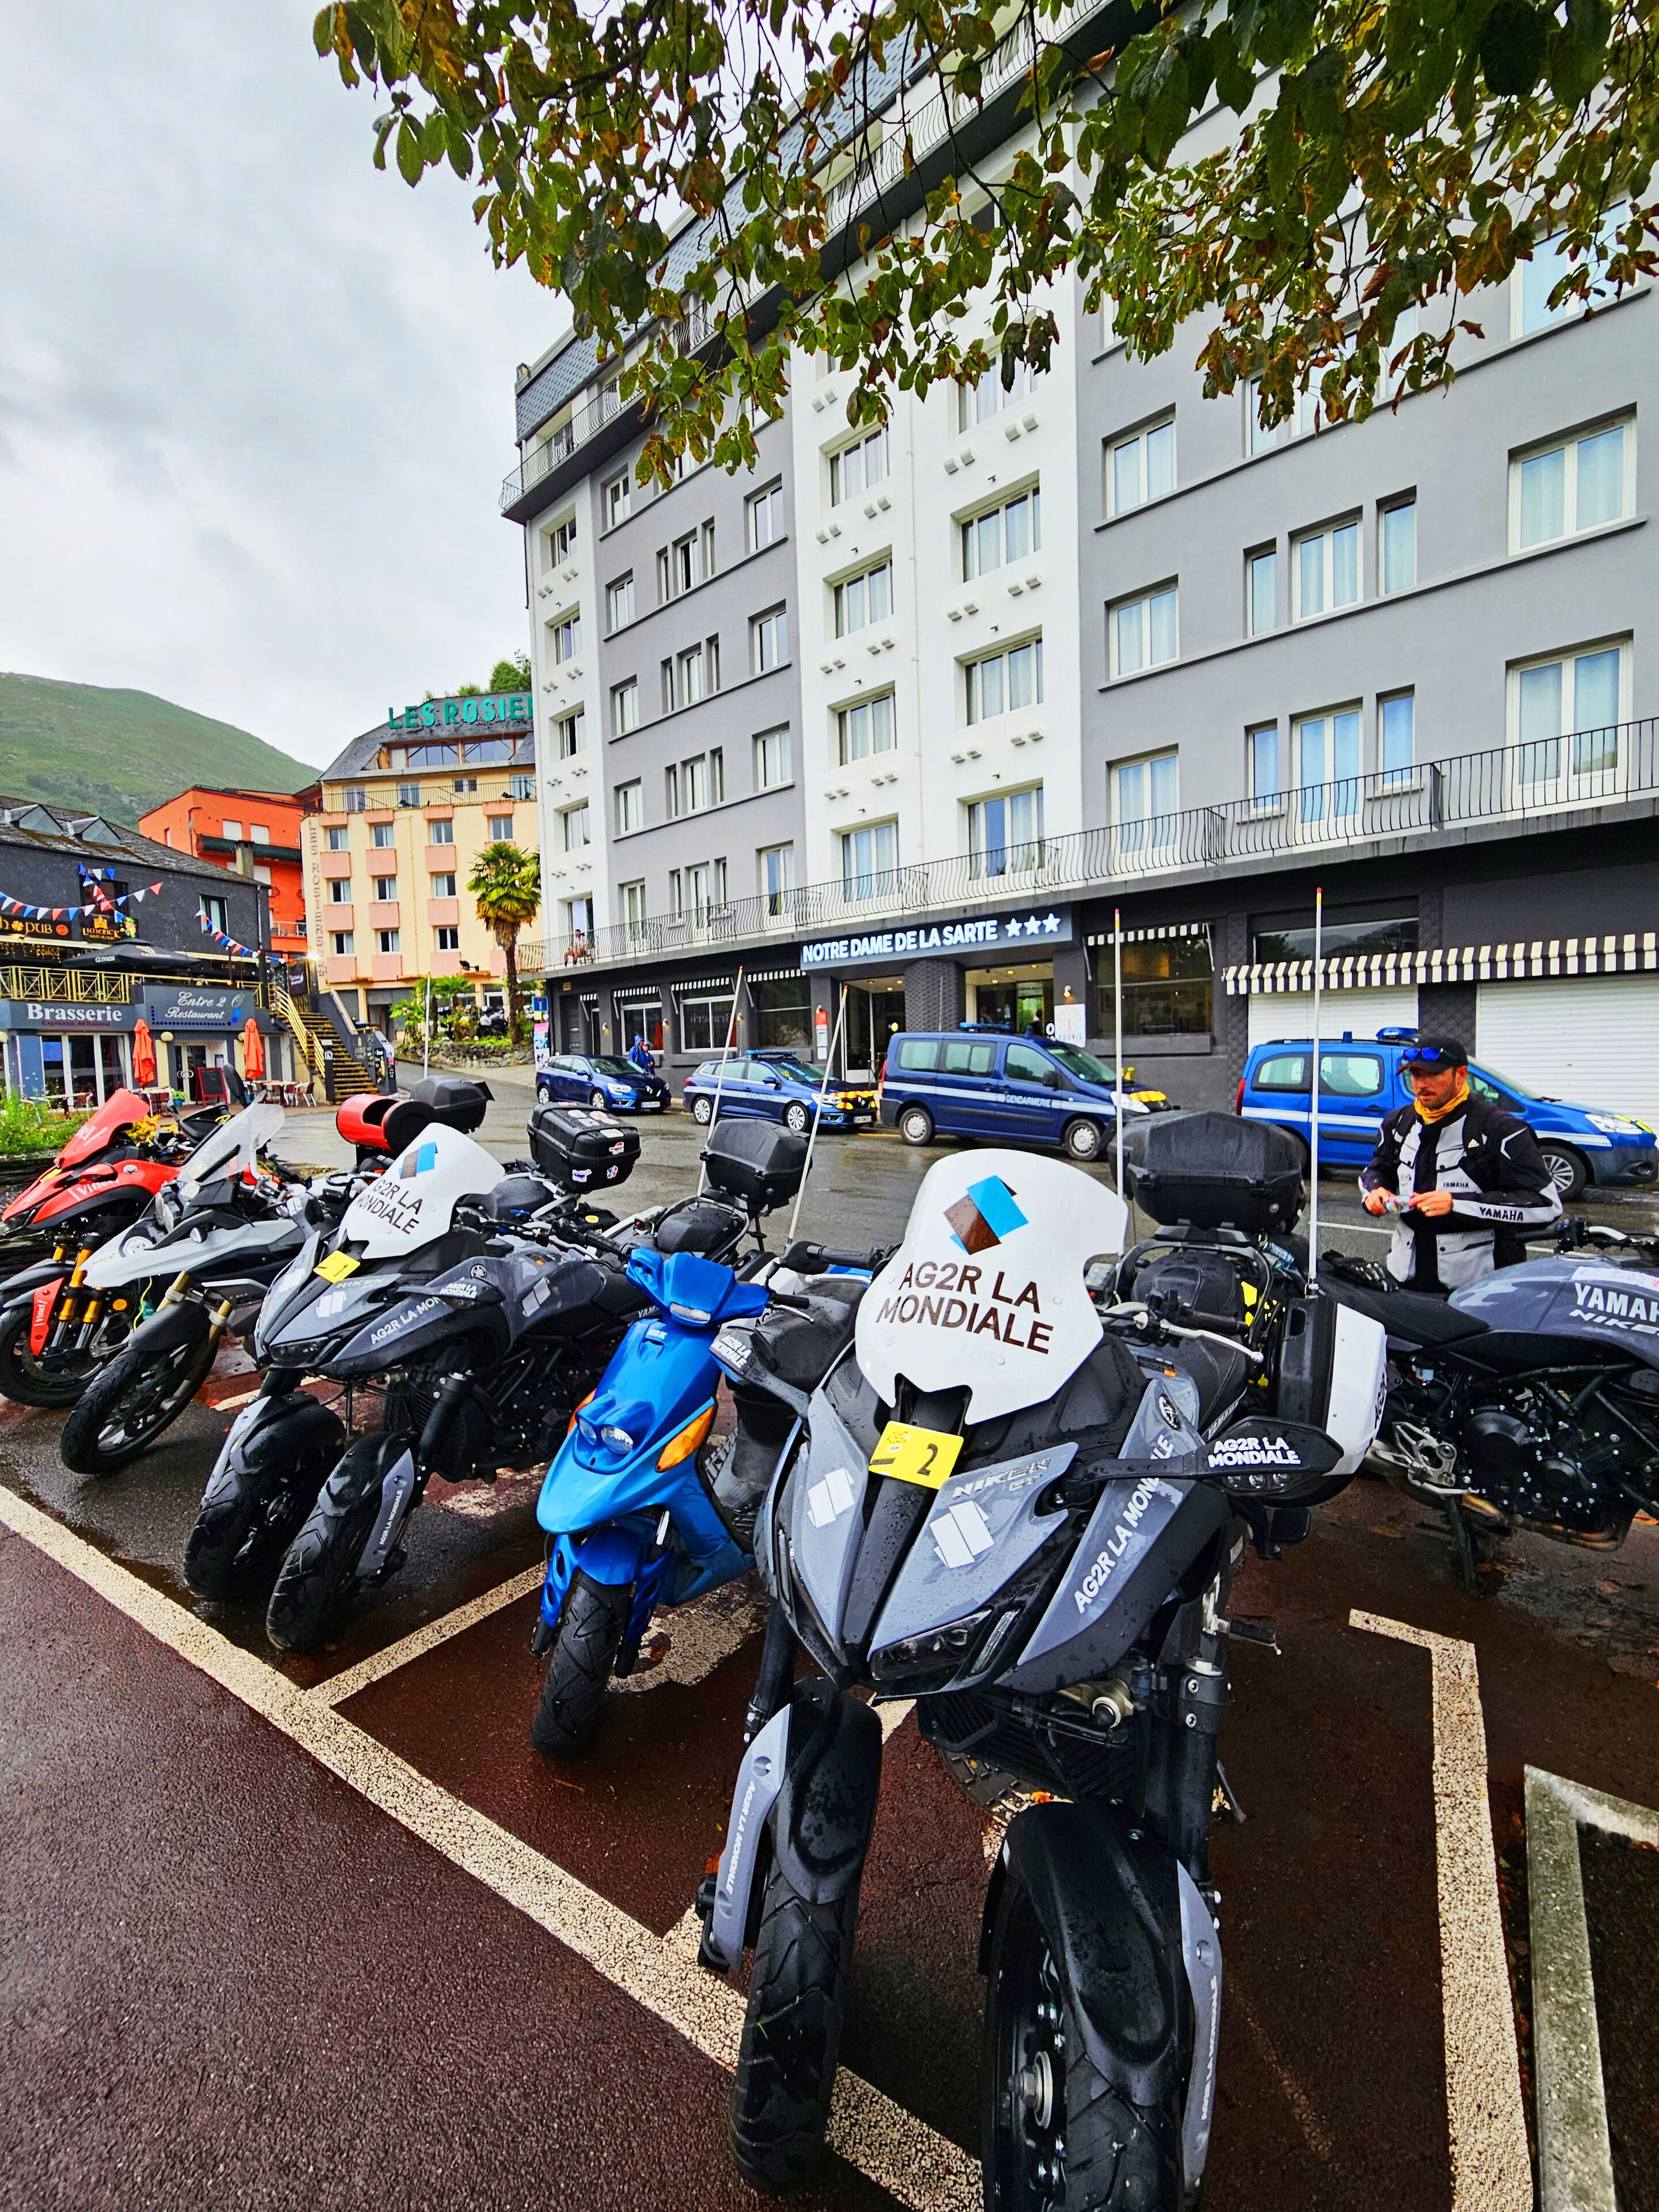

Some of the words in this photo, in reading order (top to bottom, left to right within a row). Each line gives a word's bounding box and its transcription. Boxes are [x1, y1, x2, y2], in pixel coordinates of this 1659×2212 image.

[388, 702, 436, 729] LES
[802, 940, 849, 963] NOTRE
[850, 934, 893, 957] DAME
[895, 931, 918, 952] DE
[919, 927, 942, 949] LA
[942, 920, 998, 946] SARTE
[26, 1003, 122, 1021] Brasserie
[177, 991, 214, 1007] Entre
[216, 996, 226, 1007] 2
[165, 1006, 225, 1020] Restaurant
[373, 1179, 400, 1200] G2R
[397, 1191, 423, 1215] LA
[1479, 1206, 1524, 1222] YAMAHA
[898, 1261, 983, 1295] AG2R
[991, 1271, 1042, 1314] LA
[638, 1305, 660, 1319] YAM
[876, 1294, 1054, 1355] MONDIALE
[1569, 1309, 1659, 1336] NIKE
[370, 1320, 402, 1345] AG2R
[402, 1309, 418, 1325] LA
[1208, 1449, 1301, 1468] MONDIALE
[1214, 1438, 1263, 1453] AG2R
[1263, 1437, 1290, 1451] LA
[916, 1442, 938, 1476] 2
[952, 1457, 1051, 1498] NIKEN
[1074, 1551, 1116, 1615] AG2R
[1107, 1524, 1133, 1557] LA
